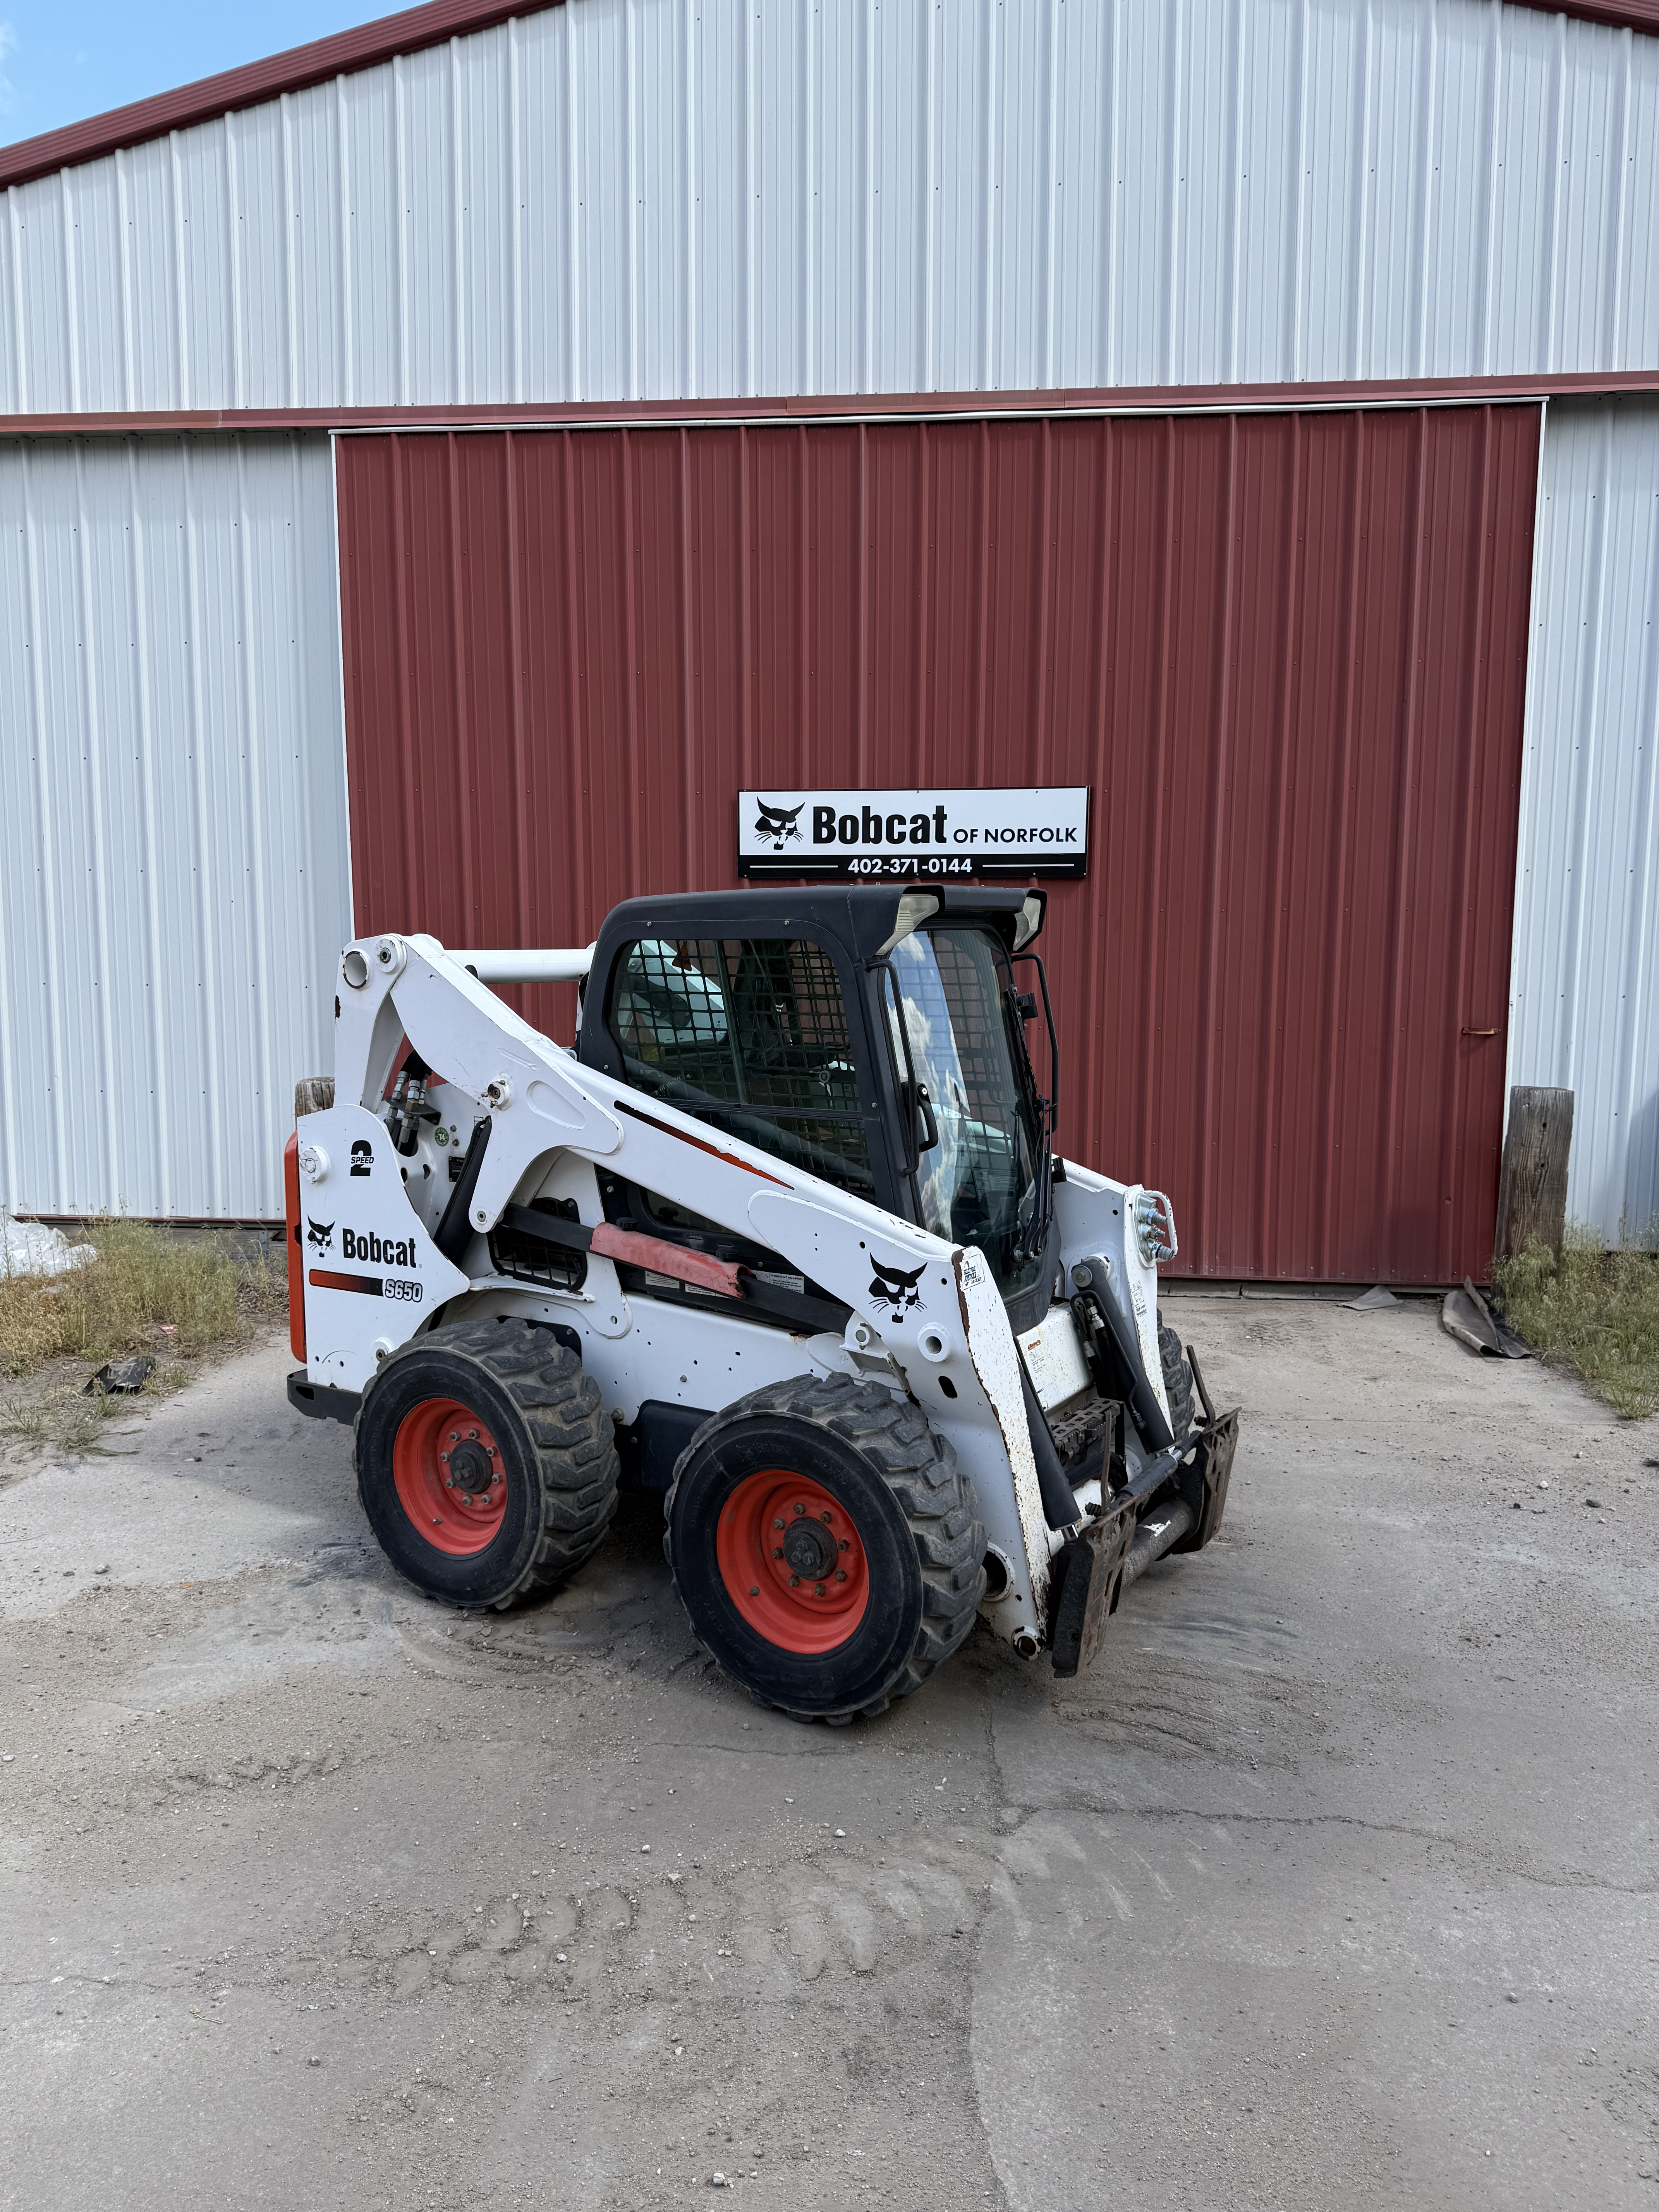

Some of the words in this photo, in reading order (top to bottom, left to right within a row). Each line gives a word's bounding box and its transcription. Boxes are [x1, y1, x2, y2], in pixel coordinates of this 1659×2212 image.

[813, 805, 947, 845] Bobcat
[953, 829, 978, 843] OF
[984, 828, 1077, 843] NORFOLK
[848, 858, 972, 873] 402-371-0144
[350, 1140, 372, 1176] 2
[342, 1228, 417, 1268] Bobcat
[385, 1278, 423, 1303] S650
